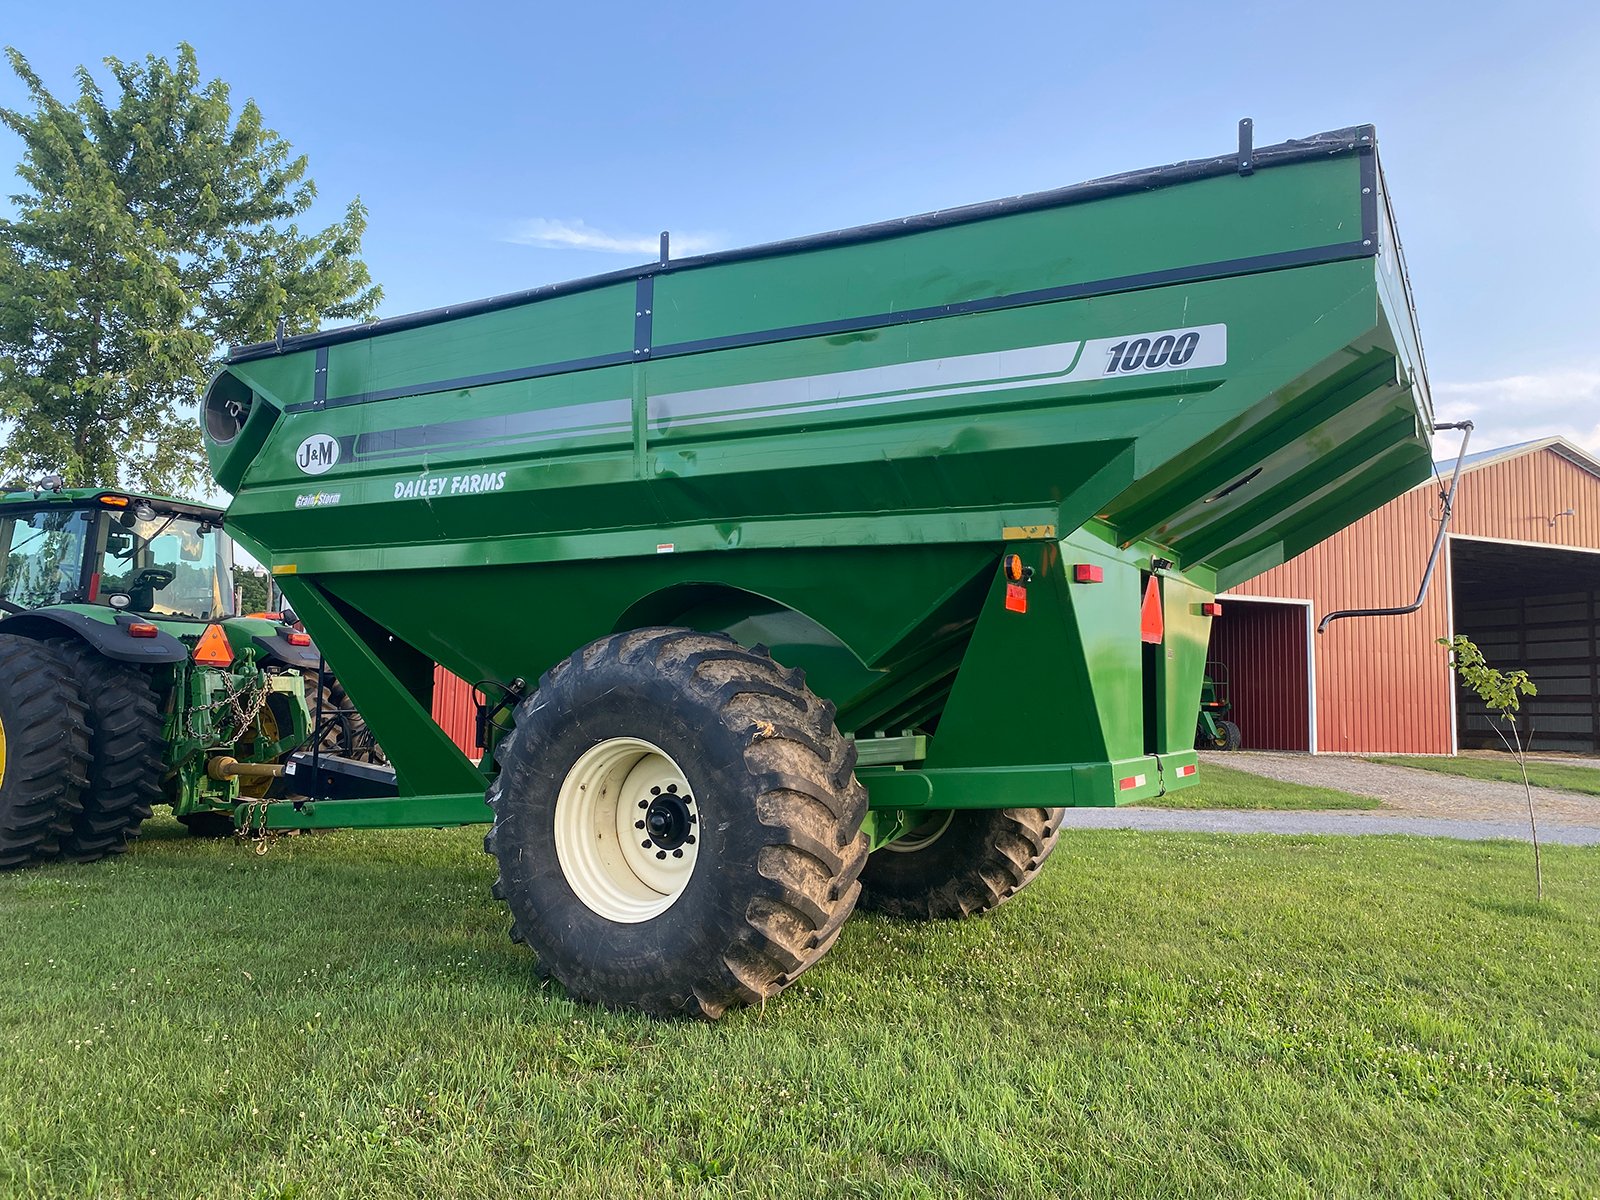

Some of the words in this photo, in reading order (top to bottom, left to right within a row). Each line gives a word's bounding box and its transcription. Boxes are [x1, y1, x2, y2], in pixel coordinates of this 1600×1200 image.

[1105, 331, 1200, 373] 1000
[299, 440, 334, 468] J&M
[393, 477, 448, 499] DAILEY
[450, 471, 507, 494] FARMS
